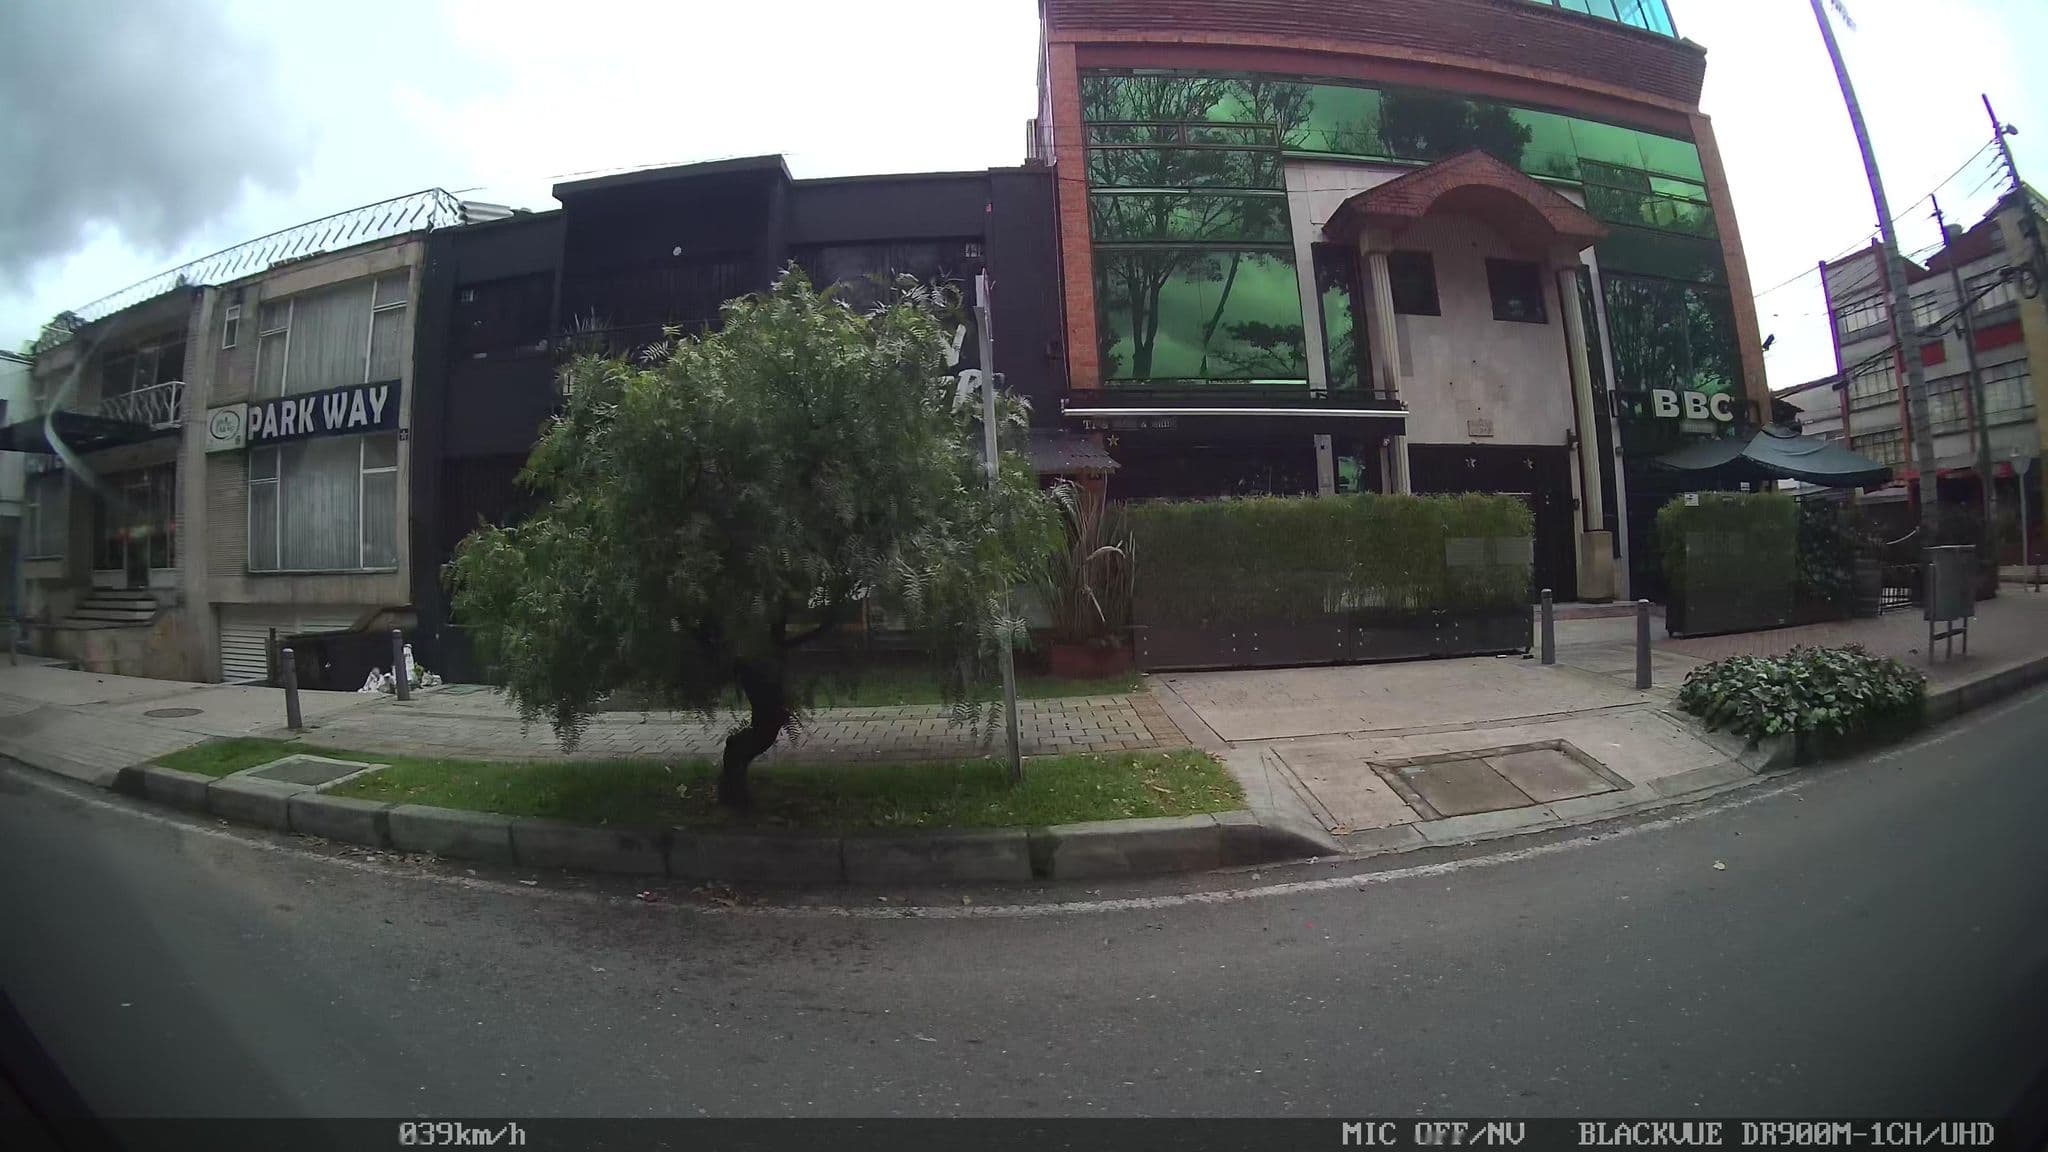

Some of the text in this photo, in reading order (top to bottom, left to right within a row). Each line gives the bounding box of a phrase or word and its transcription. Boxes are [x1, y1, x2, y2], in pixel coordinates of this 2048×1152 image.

[248, 397, 316, 440] PARK
[323, 385, 388, 430] WAY
[1652, 388, 1734, 422] BBC
